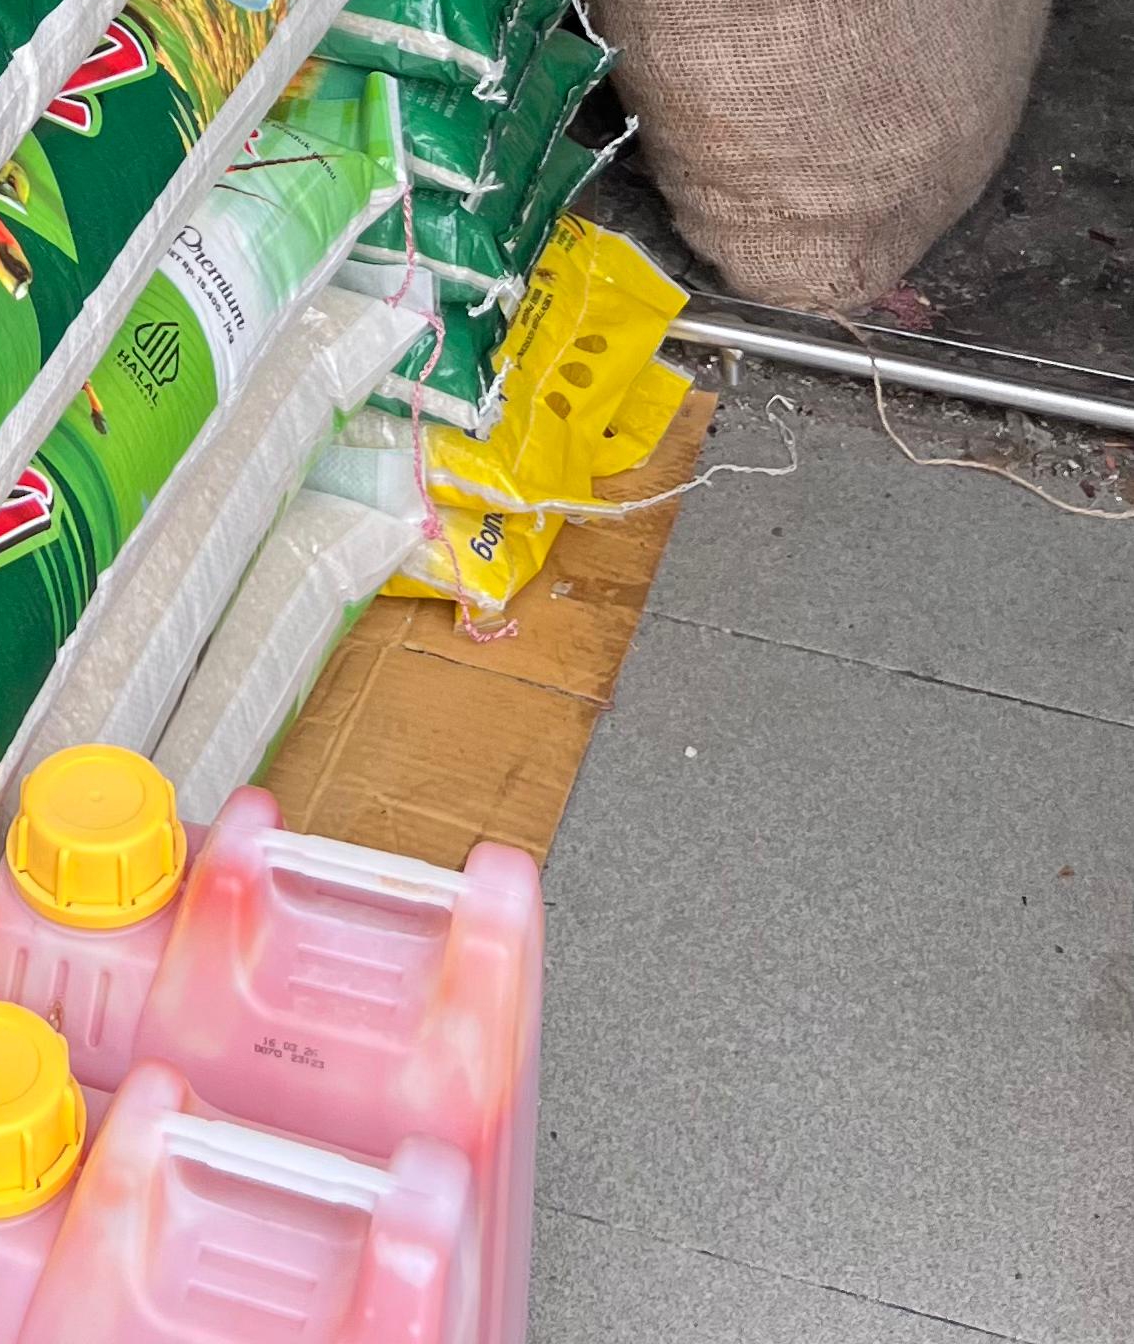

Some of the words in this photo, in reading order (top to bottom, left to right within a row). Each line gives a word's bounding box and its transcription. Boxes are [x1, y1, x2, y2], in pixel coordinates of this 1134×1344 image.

[173, 224, 245, 331] Premium
[117, 348, 160, 408] HALAL
[475, 511, 507, 563] ulog
